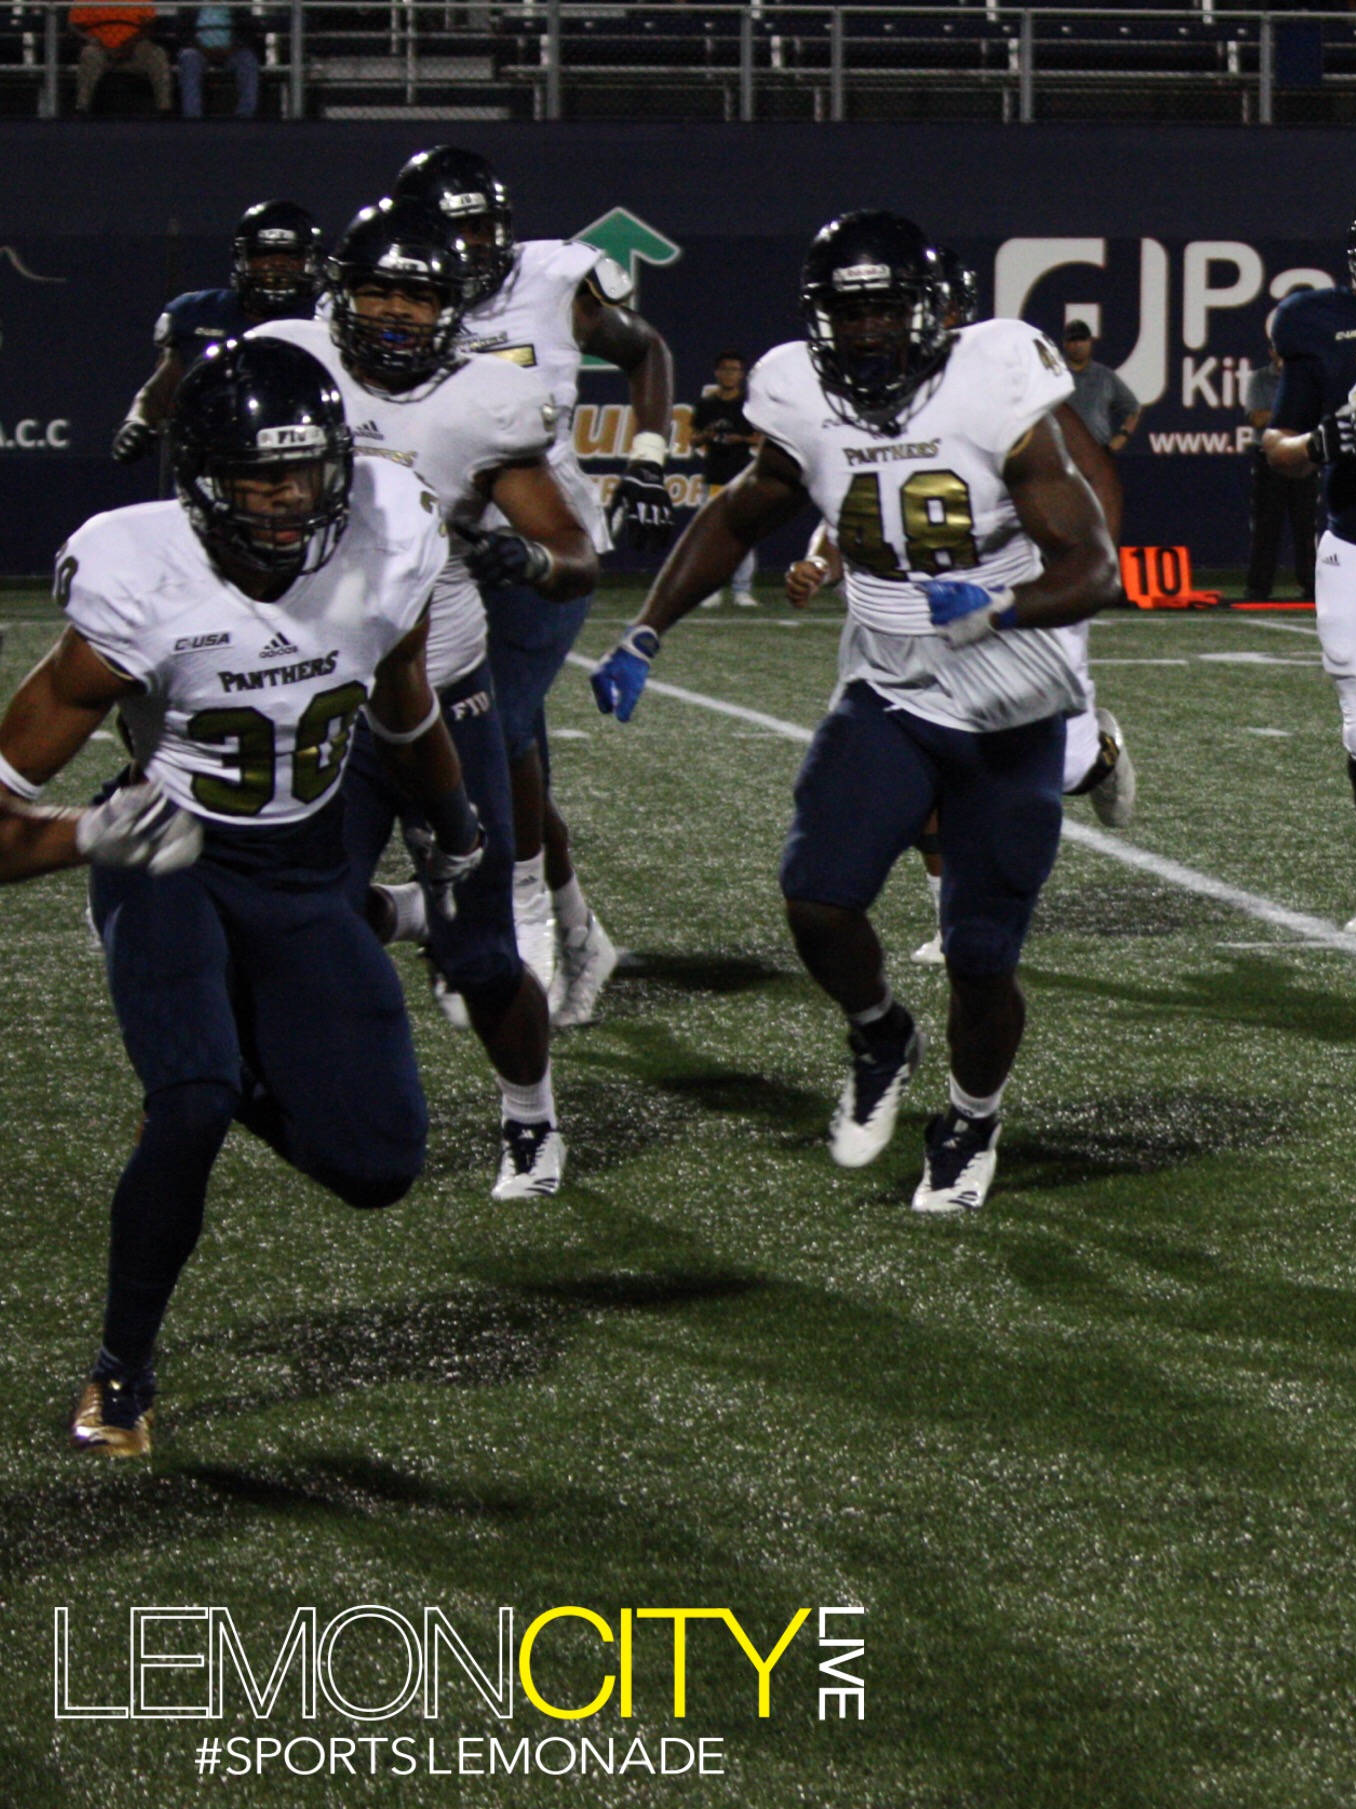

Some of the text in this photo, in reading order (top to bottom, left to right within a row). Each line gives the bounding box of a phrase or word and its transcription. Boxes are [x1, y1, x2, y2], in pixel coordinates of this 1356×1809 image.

[1182, 356, 1253, 408] Kit
[842, 437, 942, 467] PANTHERS
[1130, 547, 1183, 597] 10
[217, 649, 341, 693] PANTHERS
[186, 679, 369, 818] 30
